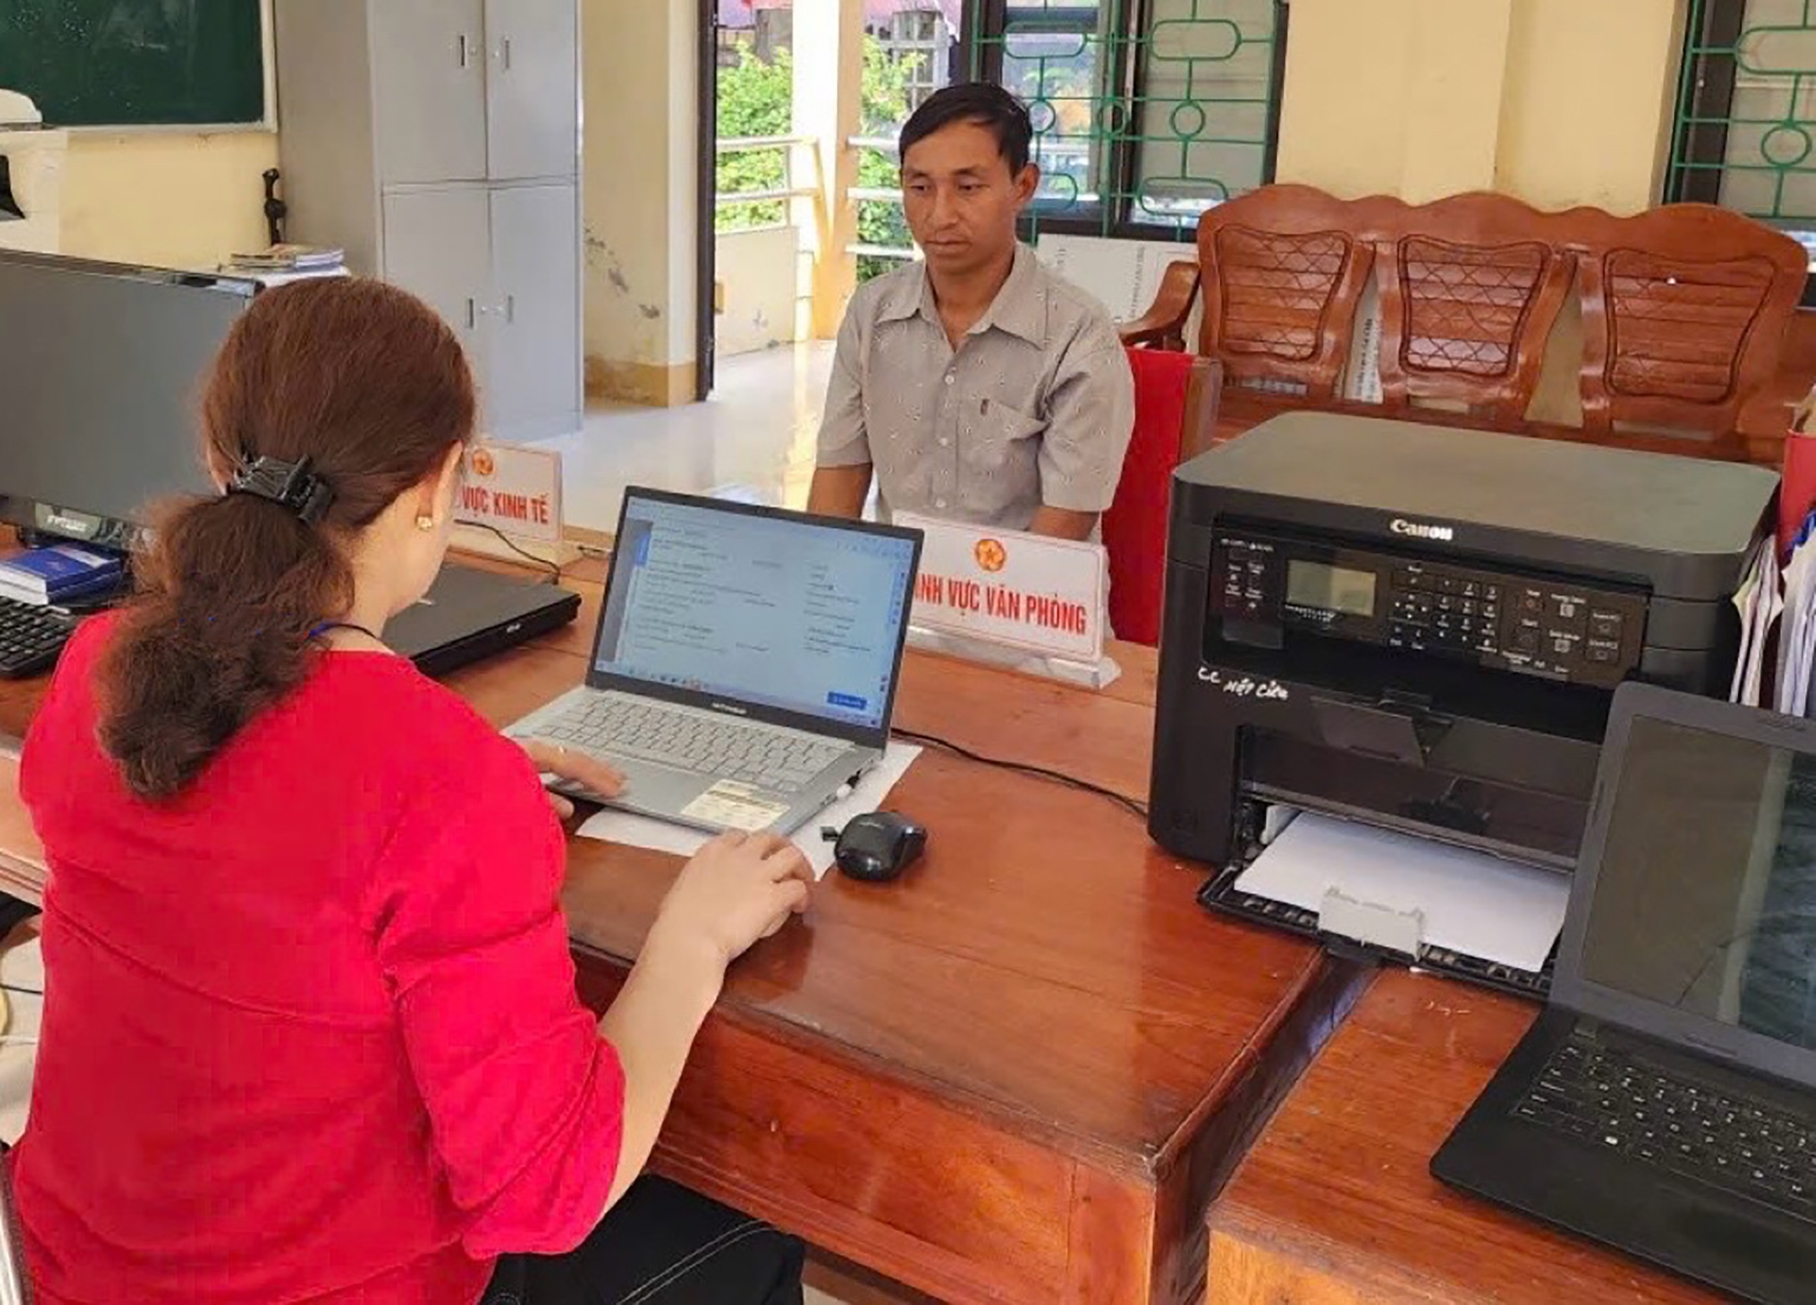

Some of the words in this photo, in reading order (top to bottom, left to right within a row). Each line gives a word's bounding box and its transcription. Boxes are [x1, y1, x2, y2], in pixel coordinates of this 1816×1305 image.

[493, 491, 527, 520] KINH
[530, 492, 548, 524] TẾ
[1390, 519, 1453, 541] Canon
[948, 577, 980, 617] VỰC
[987, 584, 1020, 620] VĂN
[1026, 593, 1086, 635] PHÒNG
